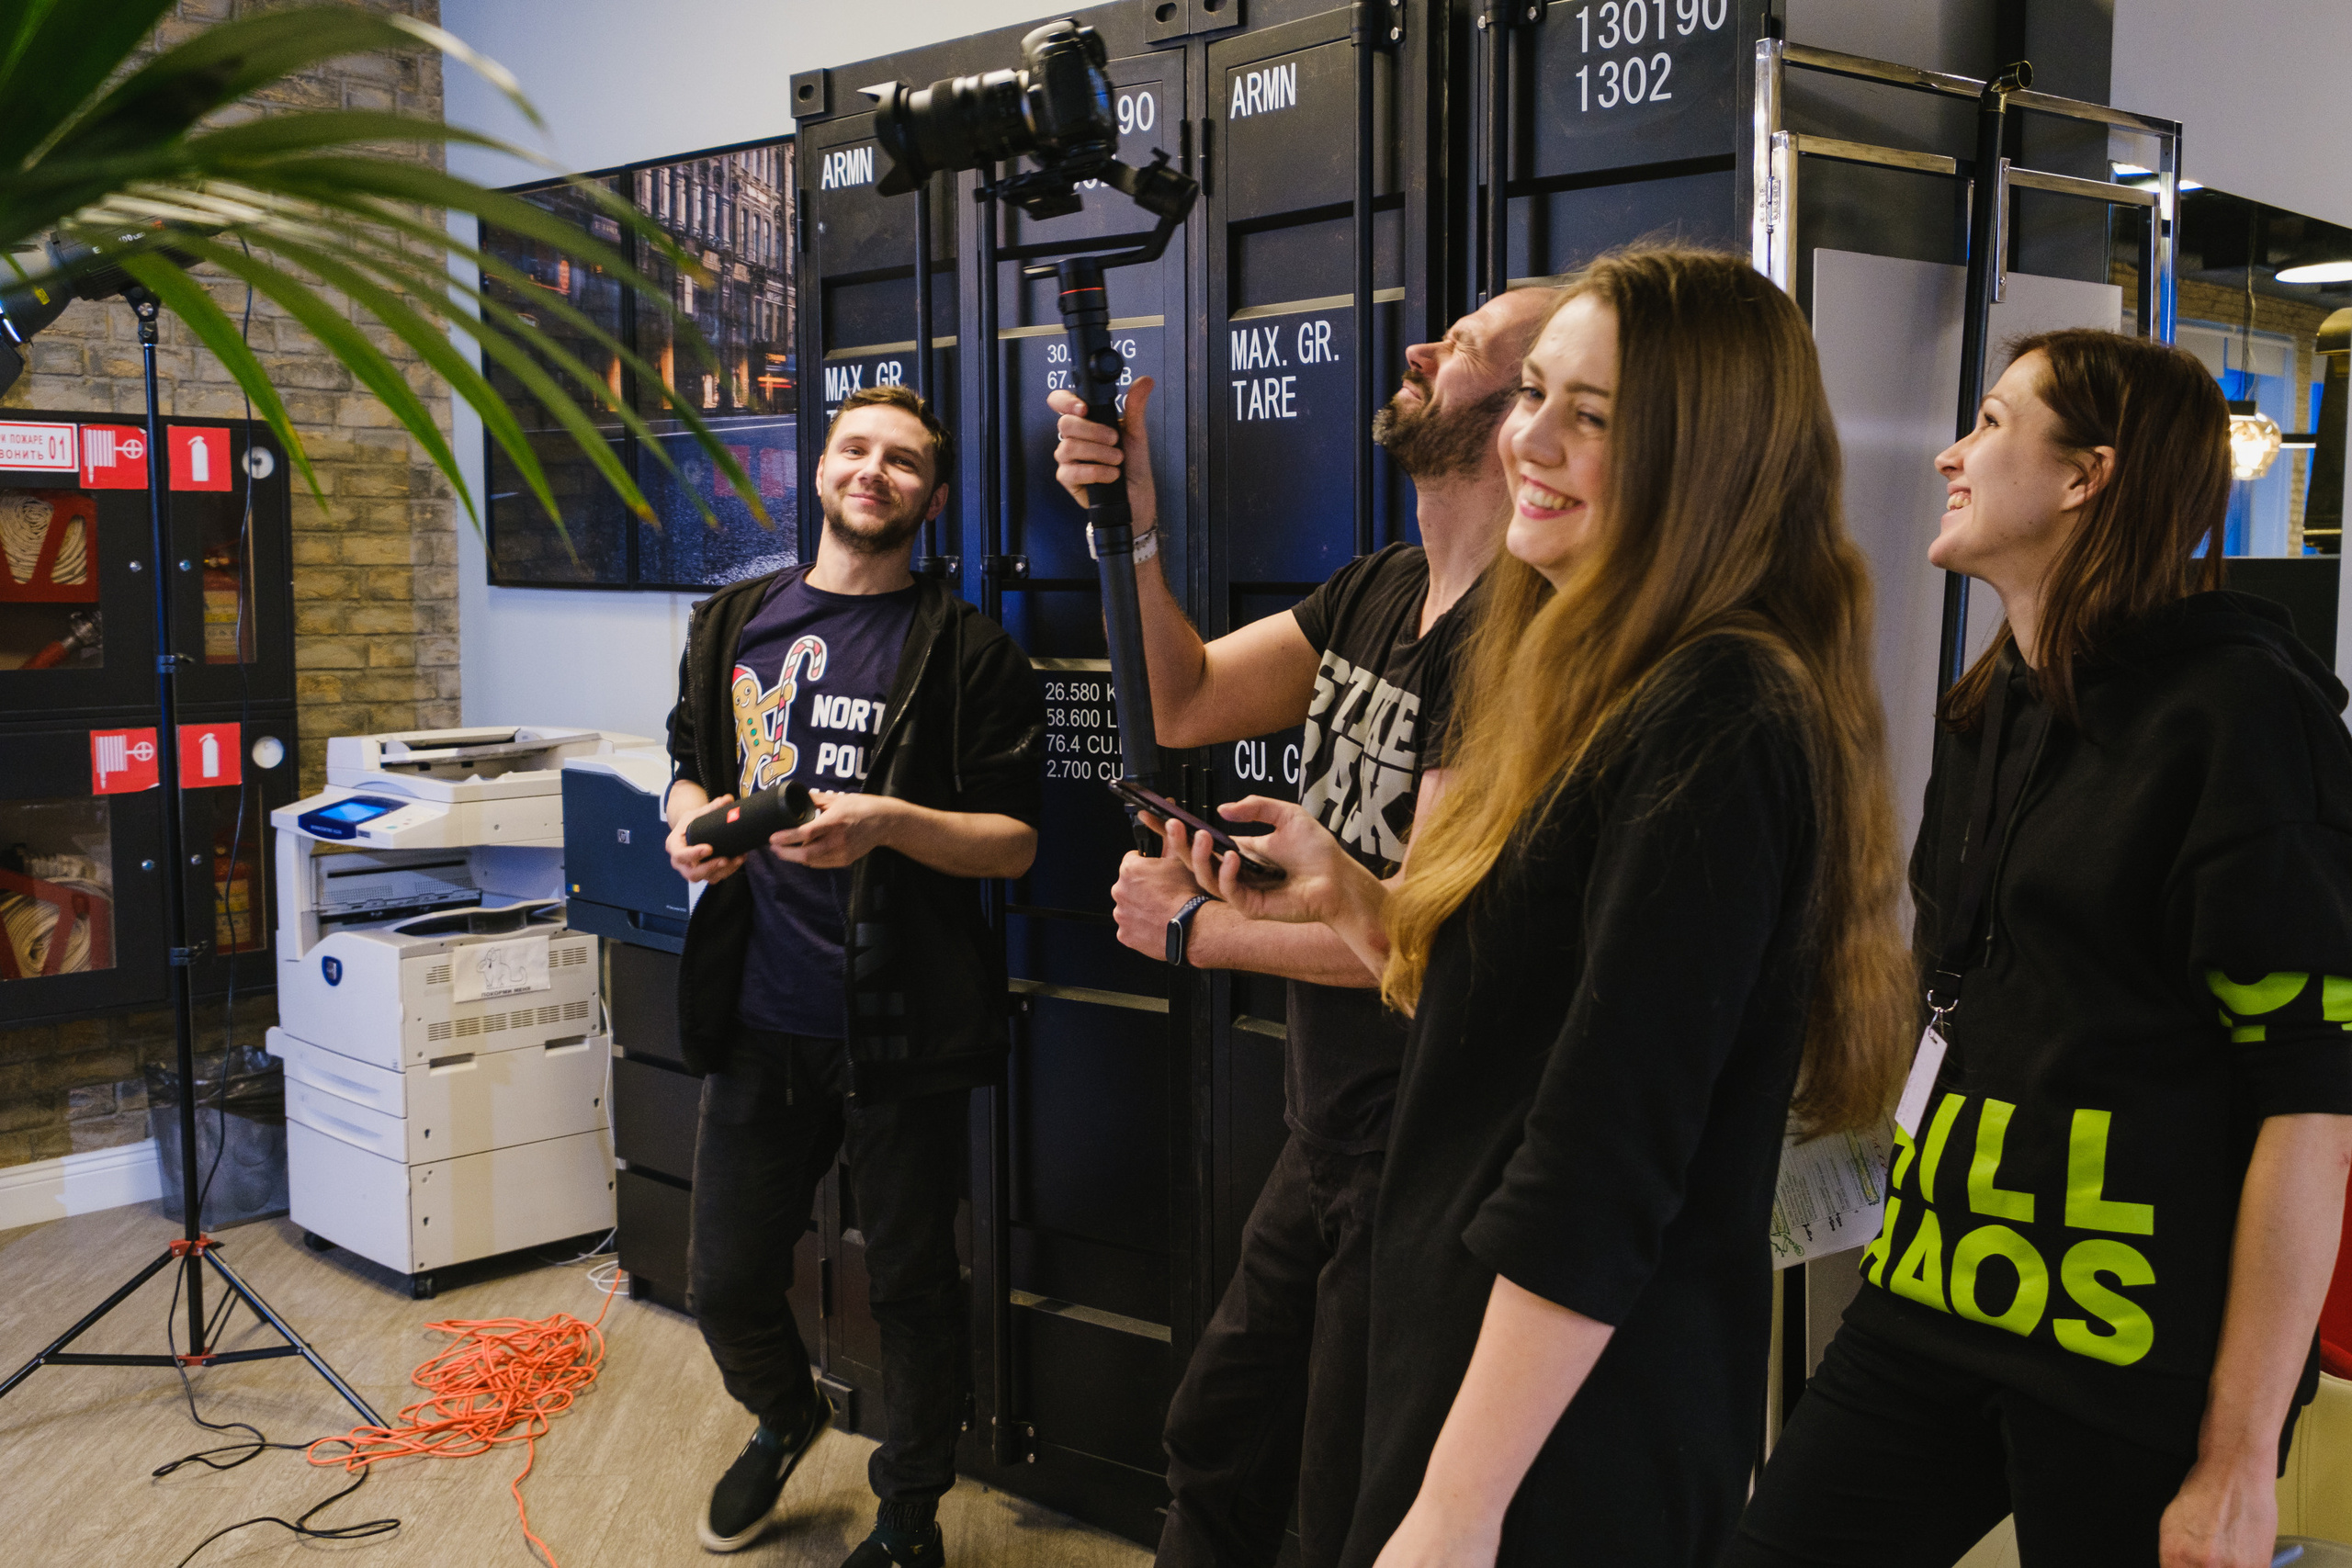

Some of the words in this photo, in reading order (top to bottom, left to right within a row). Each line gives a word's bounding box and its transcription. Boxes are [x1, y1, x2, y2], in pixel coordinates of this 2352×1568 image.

[1576, 0, 1728, 52] 130190
[1229, 62, 1296, 119] ARMN
[1576, 52, 1672, 112] 1302
[820, 146, 873, 190] ARMN
[1231, 325, 1287, 371] MAX.
[1297, 320, 1340, 364] GR.
[1232, 375, 1297, 421] TARE
[10, 434, 43, 446] ПОЖАРЕ
[49, 435, 65, 460] 01
[1046, 682, 1101, 702] 26.580
[1106, 682, 1117, 702] K
[810, 694, 887, 735] NORT
[1046, 708, 1101, 728] 58.600
[815, 741, 874, 781] POL
[1046, 734, 1080, 753] 76.4
[1087, 735, 1123, 755] CU.
[1235, 739, 1273, 782] CU.
[1046, 760, 1091, 780] 2.700
